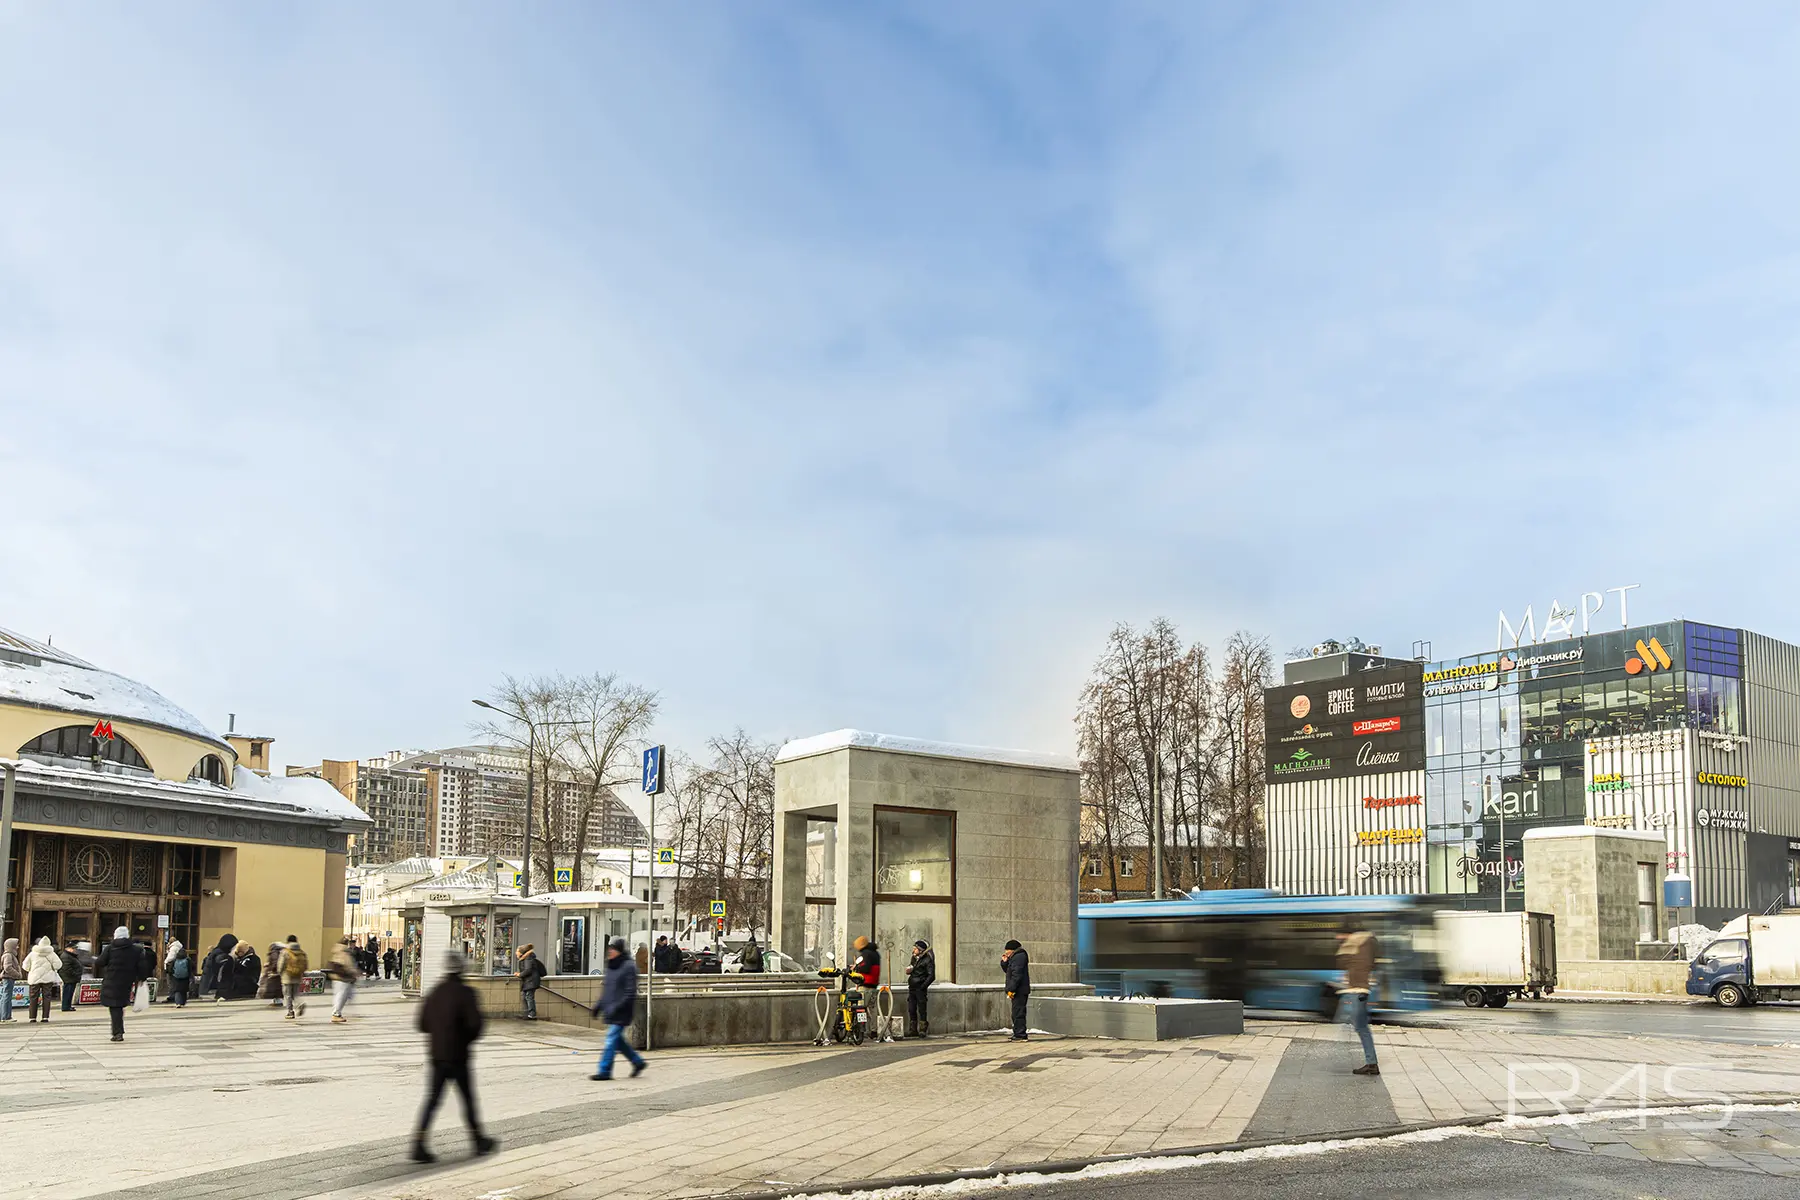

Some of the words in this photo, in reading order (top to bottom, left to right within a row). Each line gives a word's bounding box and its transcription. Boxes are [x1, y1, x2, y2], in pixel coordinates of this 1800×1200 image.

[1497, 583, 1641, 650] МАРТ
[1516, 648, 1584, 669] Диванчик.ру
[1422, 661, 1498, 683] МАГНОЛИЯ
[1332, 687, 1355, 703] PRICE
[1366, 681, 1405, 698] МИЛТИ
[1422, 681, 1486, 698] СУПЕРМАРКЕТ
[1328, 700, 1355, 715] COFFEE
[1356, 741, 1400, 767] Алёнка
[1273, 757, 1331, 771] МАГНОЛИЯ
[1586, 781, 1631, 793] АПТЕКА
[1707, 773, 1747, 787] СТОЛОТО
[1482, 783, 1538, 815] kari
[1710, 809, 1748, 821] МУЖСКИЕ
[1710, 818, 1748, 830] СТРИЖКИ
[1359, 827, 1424, 840] МАТРЁШКА
